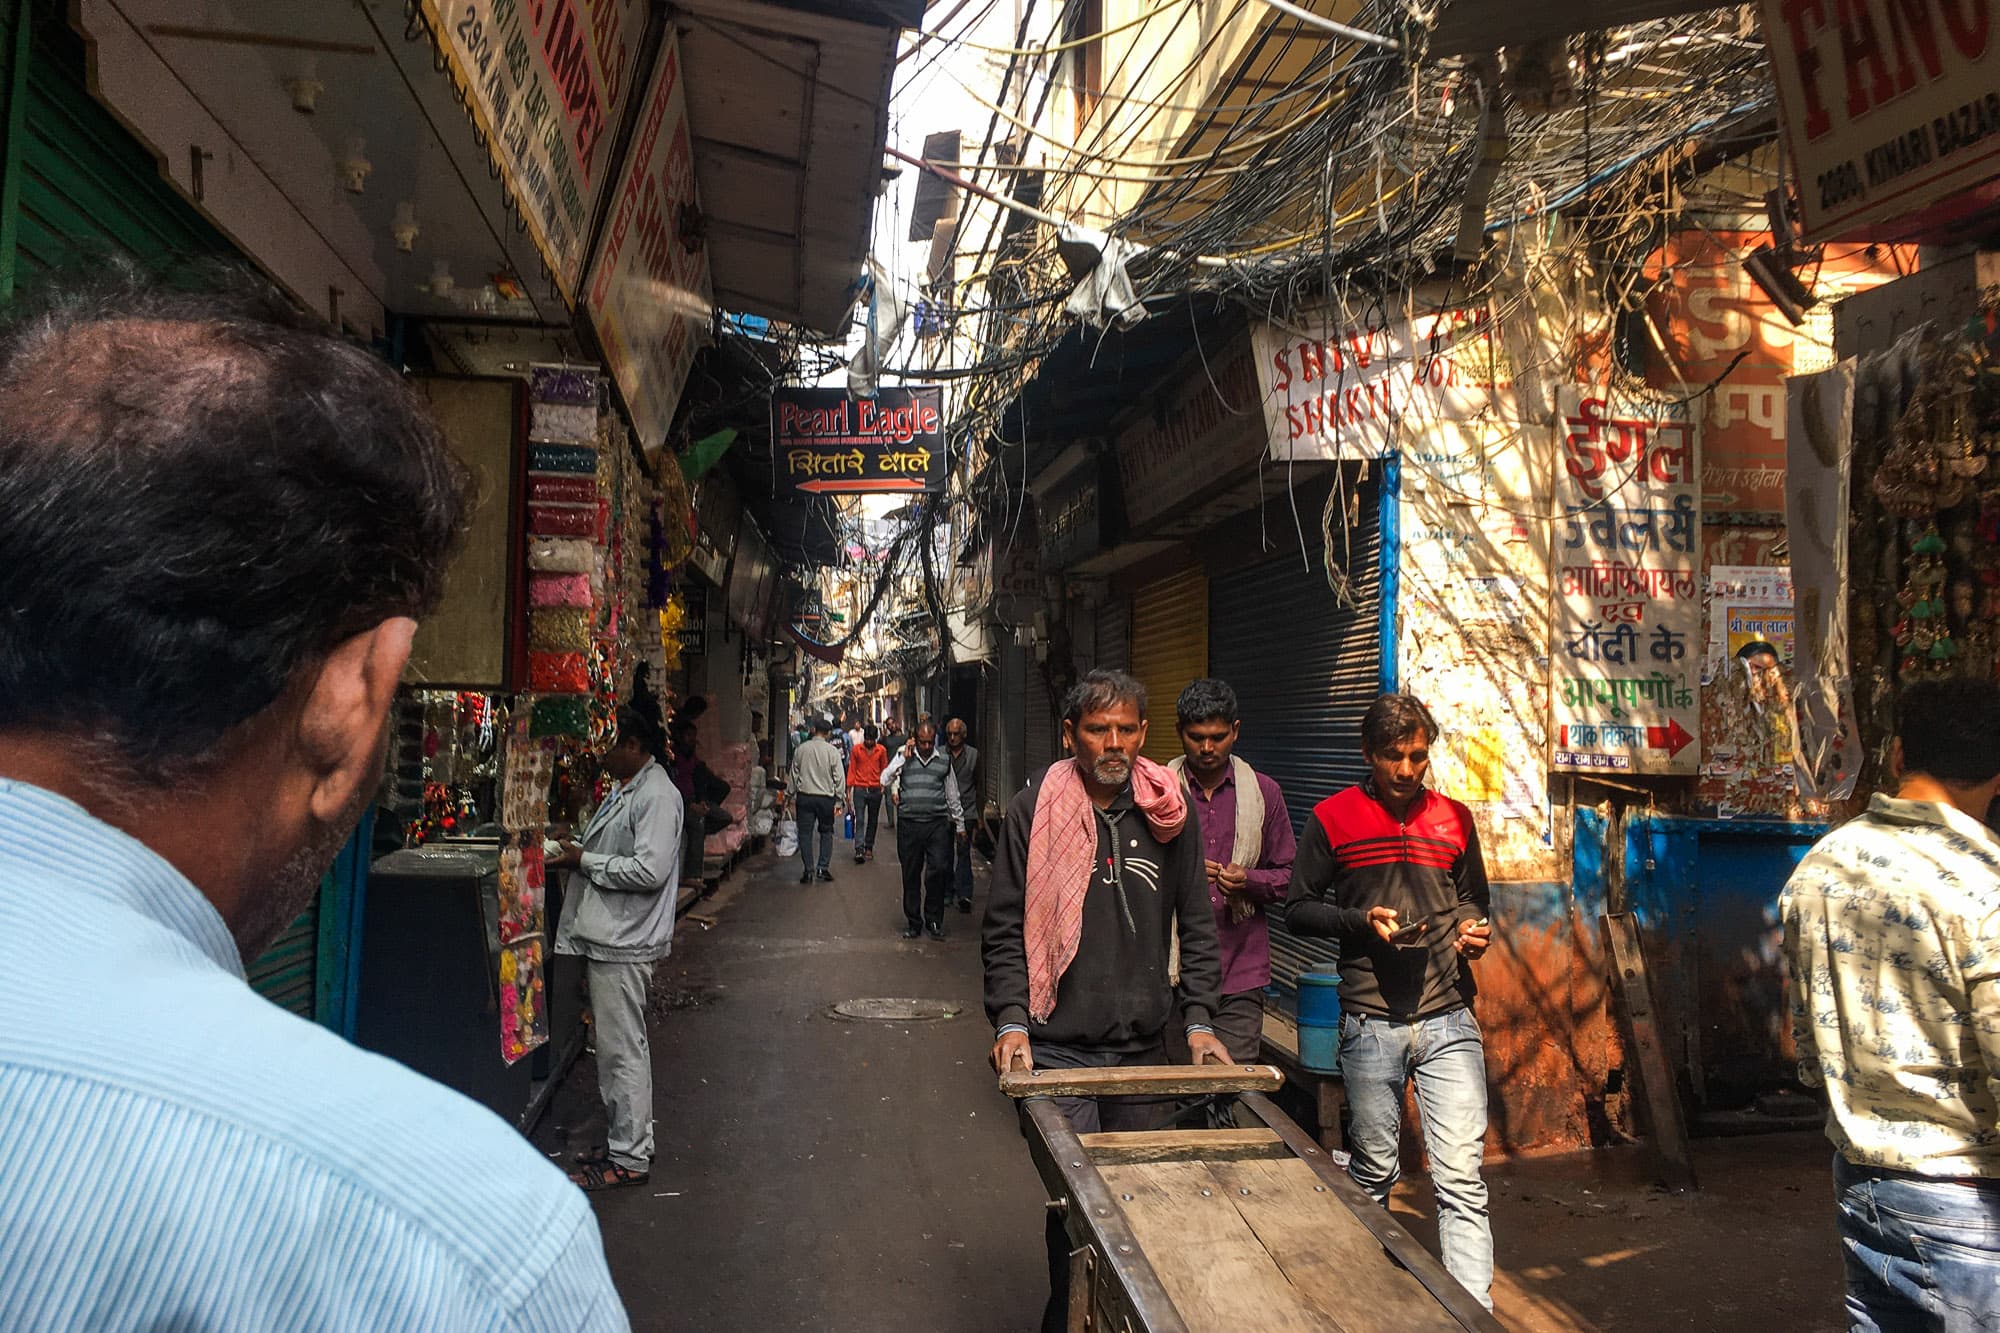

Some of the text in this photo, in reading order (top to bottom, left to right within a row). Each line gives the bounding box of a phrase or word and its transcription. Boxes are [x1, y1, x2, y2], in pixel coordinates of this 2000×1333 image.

[544, 0, 605, 190] IMPEX
[1863, 122, 1933, 188] KINARI
[1274, 325, 1376, 392] SHIV
[780, 399, 939, 444] Pearl Eagle
[787, 446, 931, 476] सितारे वाले
[1566, 398, 1696, 500] ईगल
[1565, 494, 1696, 552] ज्वेलर्स
[1650, 623, 1686, 663] के
[1730, 617, 1743, 633] श्री
[1766, 621, 1788, 634] लाल
[1570, 719, 1598, 747] थोक
